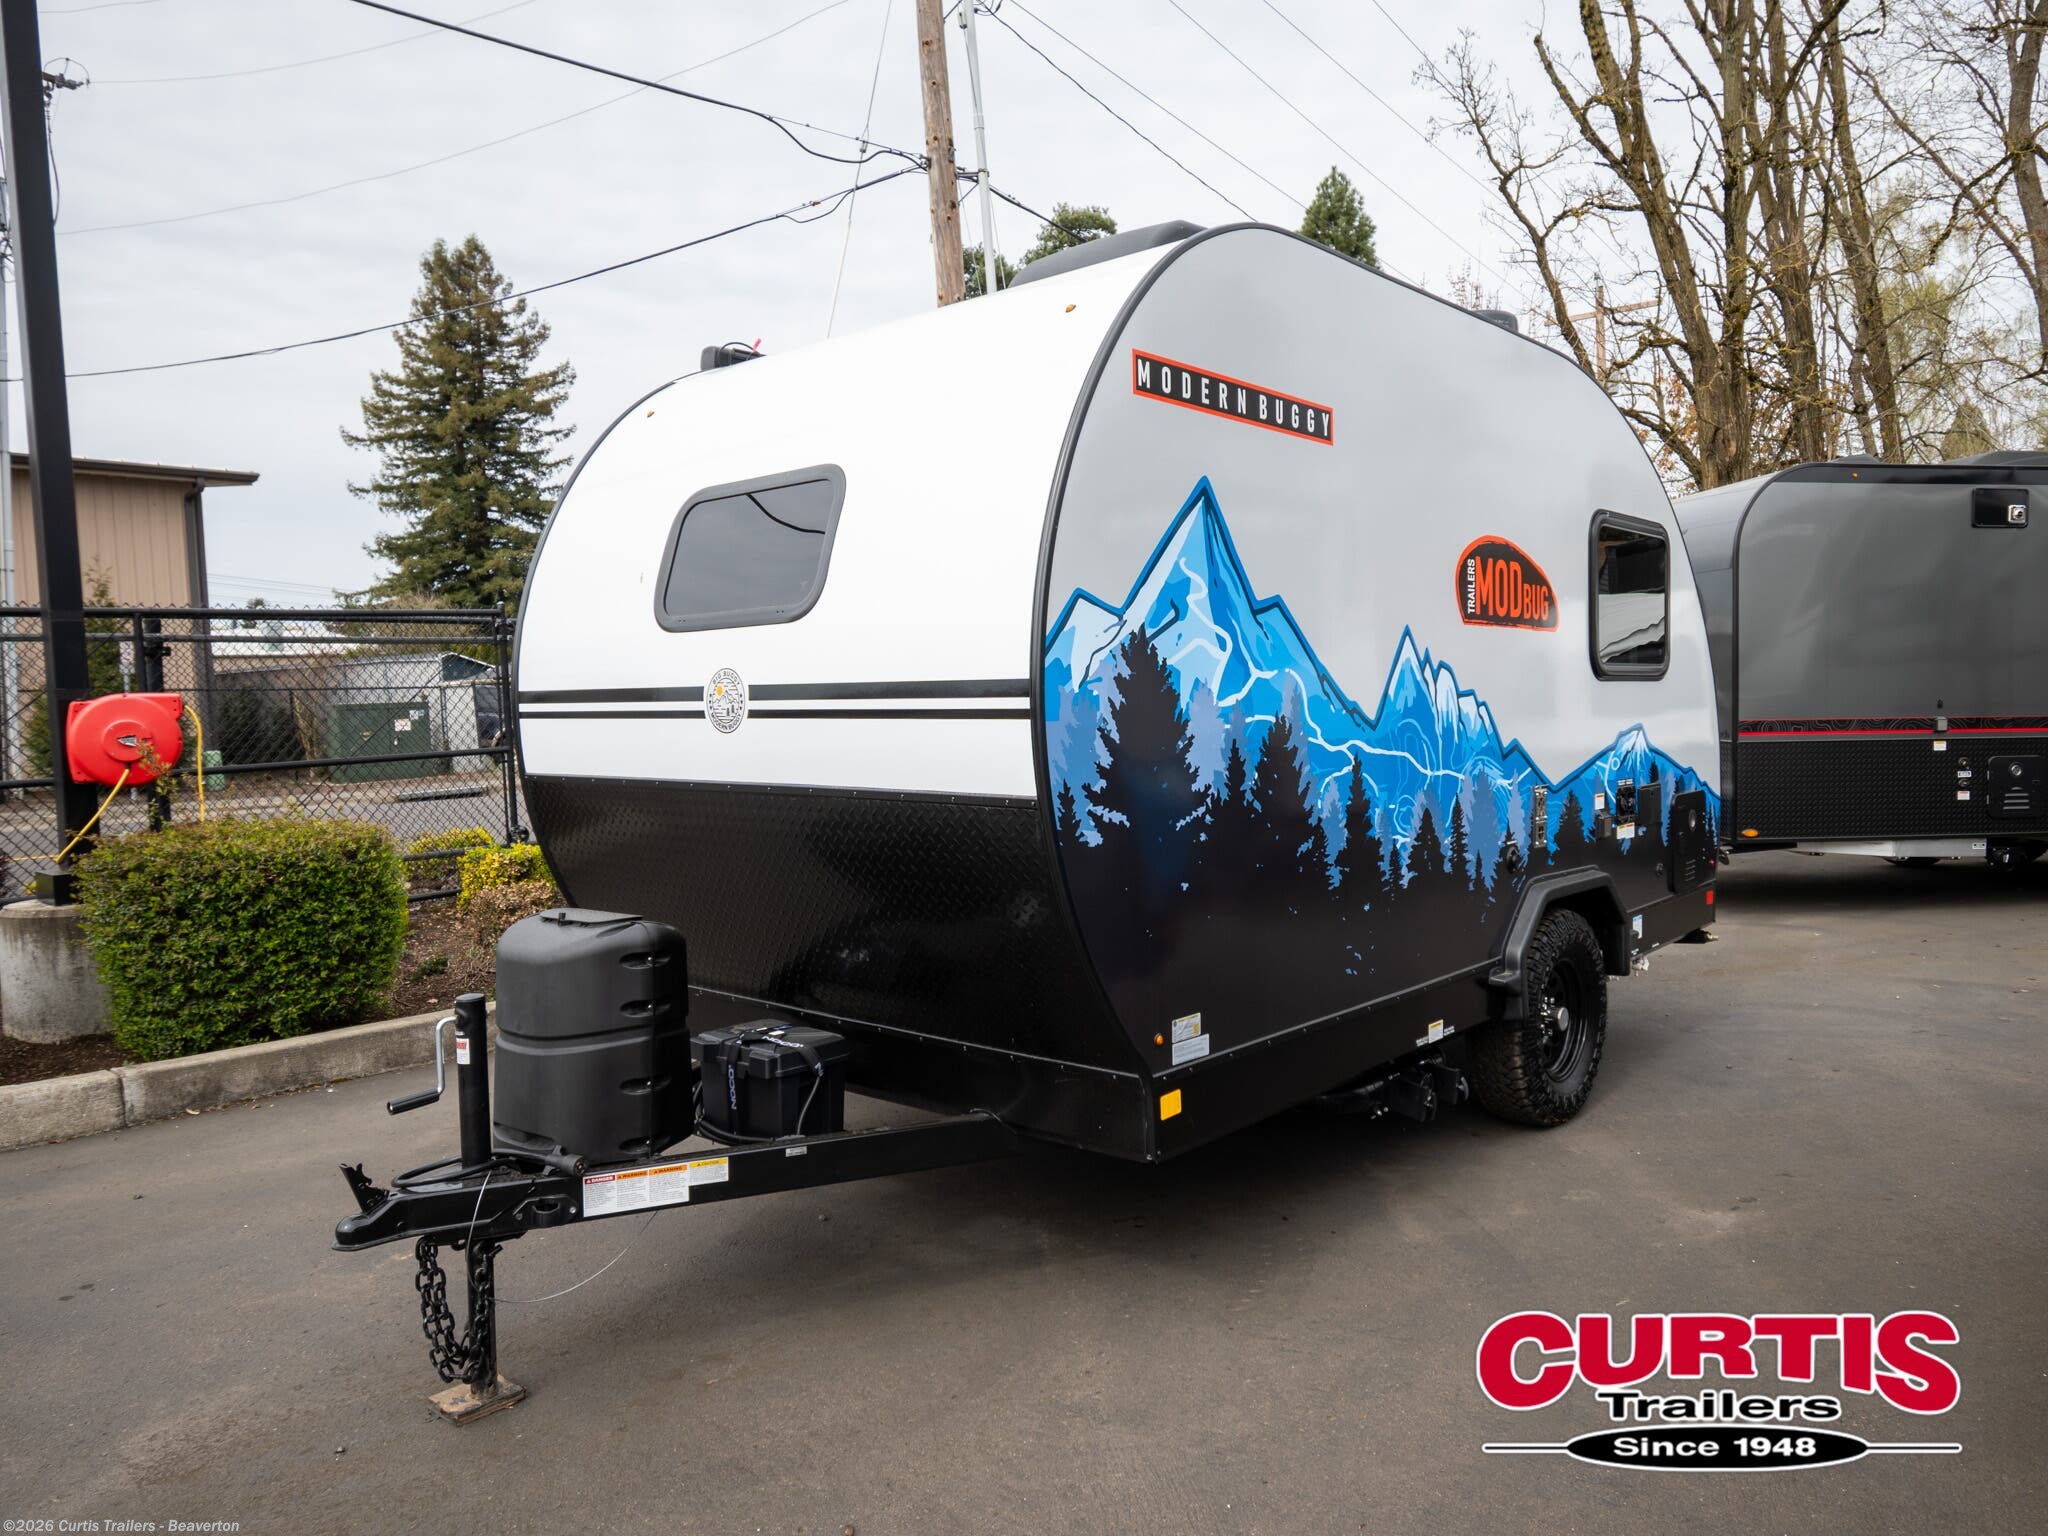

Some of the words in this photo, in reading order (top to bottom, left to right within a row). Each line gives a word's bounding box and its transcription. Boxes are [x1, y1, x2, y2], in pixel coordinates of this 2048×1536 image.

[1136, 358, 1247, 415] MODERN
[1258, 393, 1330, 437] BUGGY
[1467, 558, 1476, 614] TRAILERS
[591, 1175, 614, 1183] DANGER
